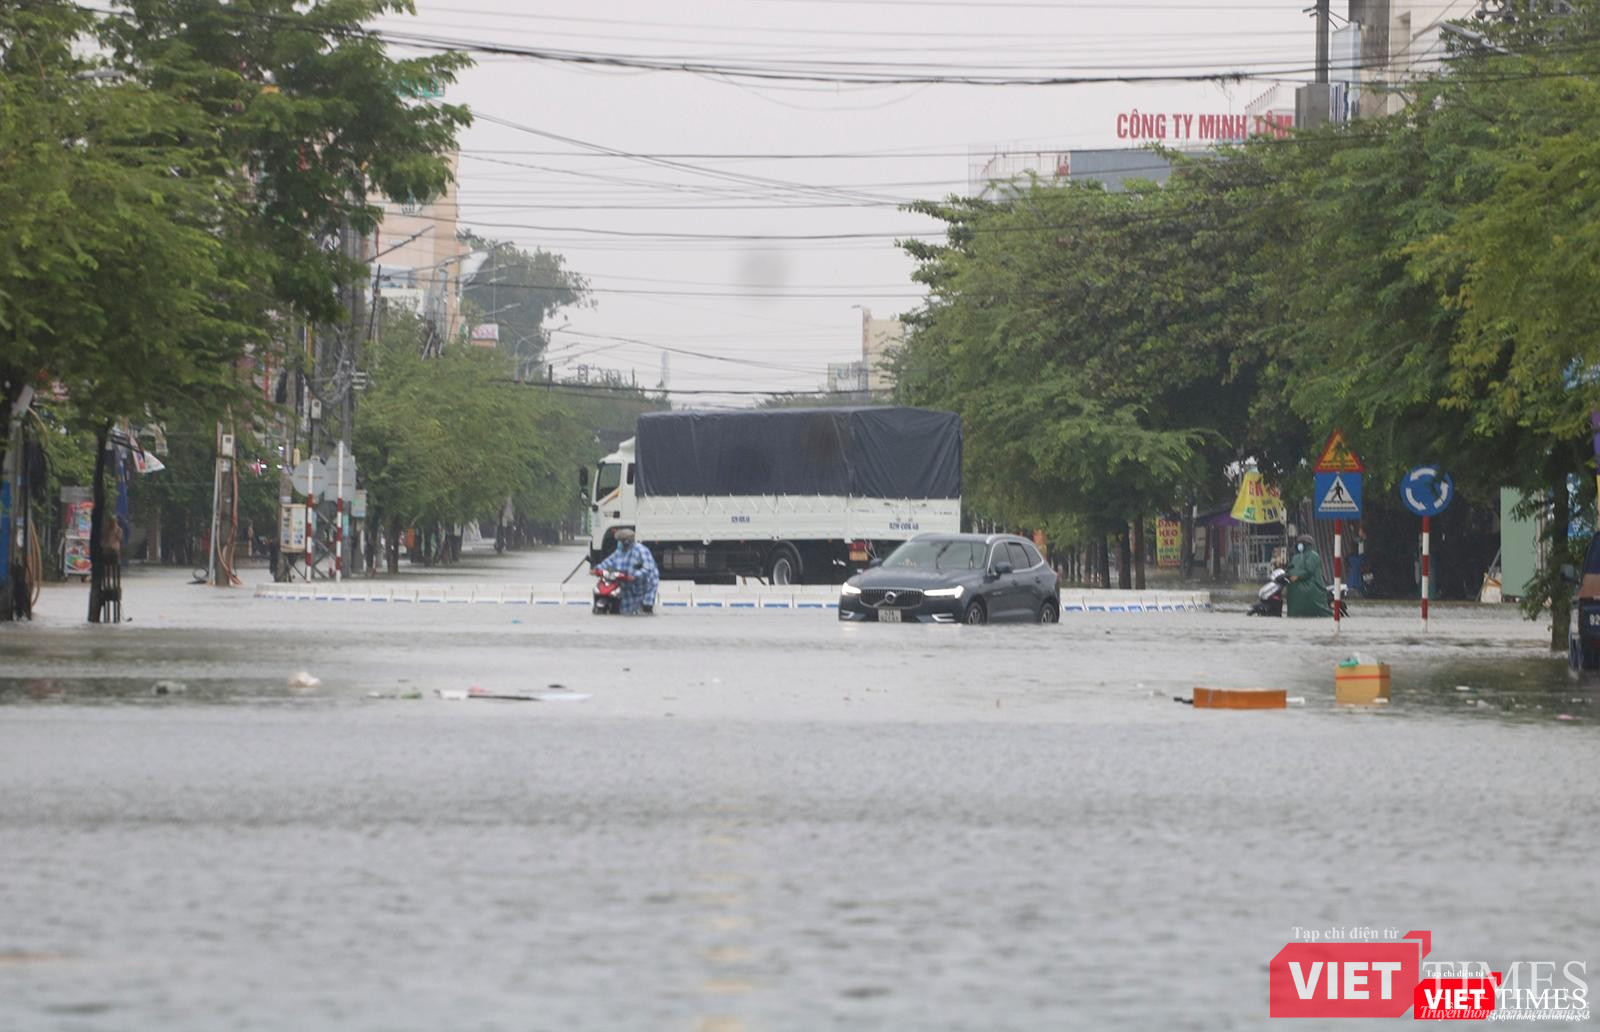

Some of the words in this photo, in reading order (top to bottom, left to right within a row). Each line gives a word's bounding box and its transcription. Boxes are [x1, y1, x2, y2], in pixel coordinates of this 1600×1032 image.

[1117, 109, 1166, 139] CÔNG
[1172, 114, 1193, 139] TY
[1199, 114, 1247, 139] MINH
[1253, 110, 1293, 139] TÂM
